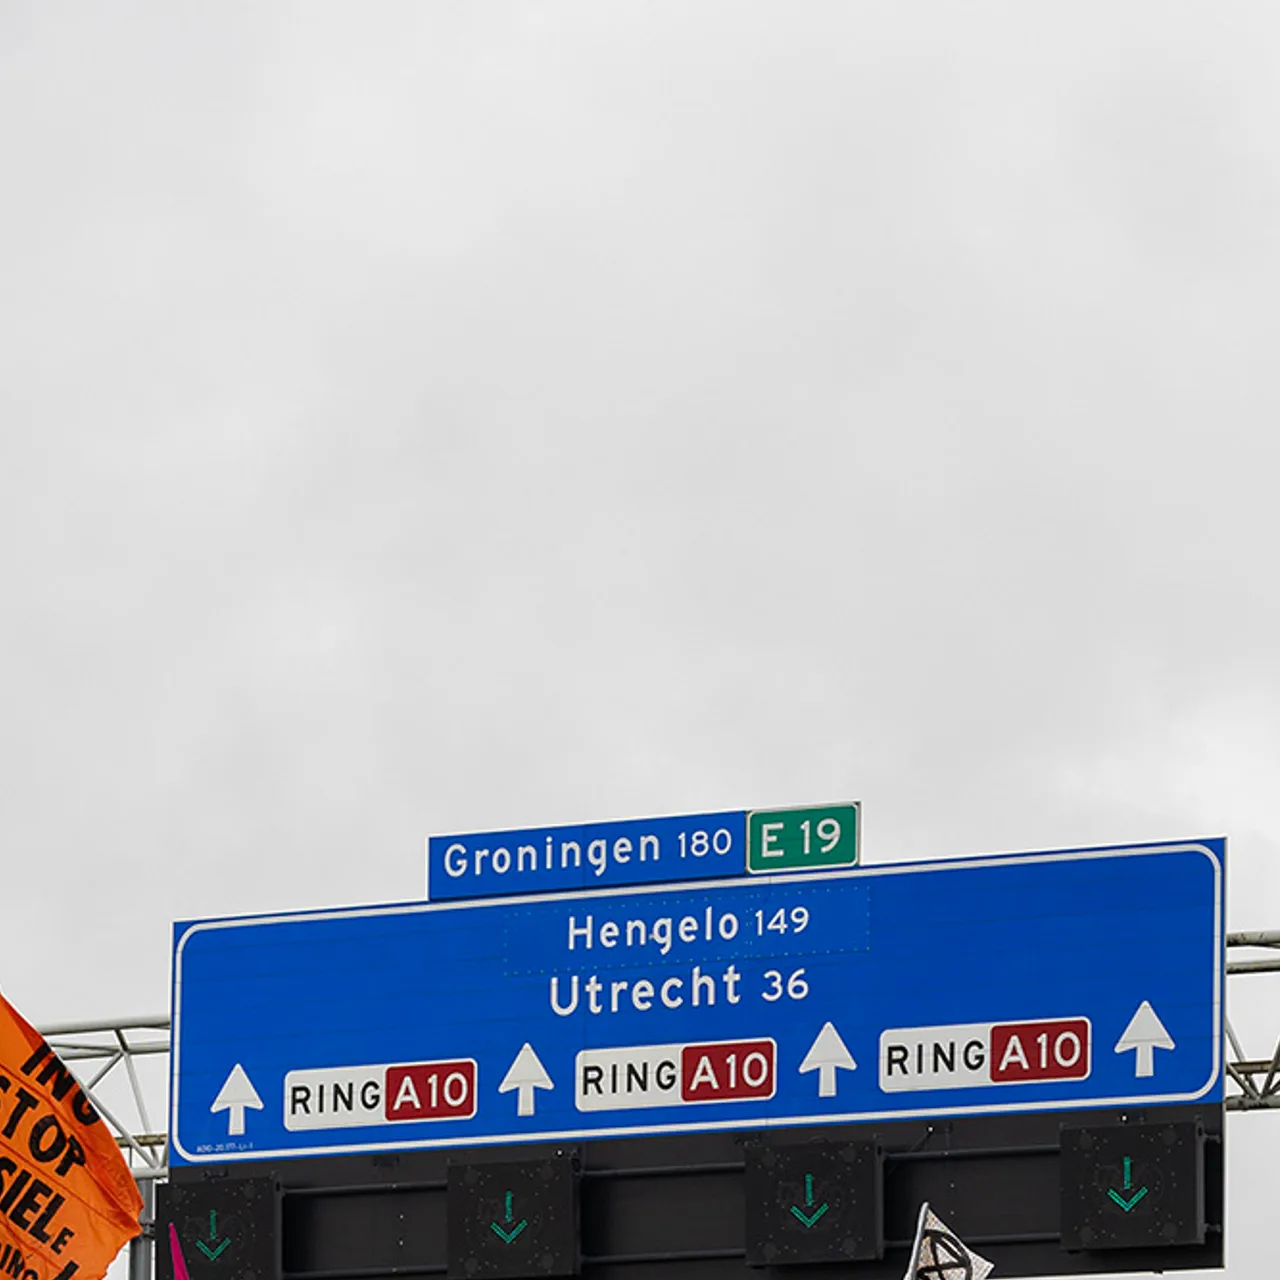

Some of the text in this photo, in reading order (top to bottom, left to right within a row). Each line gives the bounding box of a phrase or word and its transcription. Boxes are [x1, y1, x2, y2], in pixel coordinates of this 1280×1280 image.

[444, 829, 732, 877] Groningen 180
[761, 818, 841, 858] E 19
[568, 906, 809, 955] Hengelo 149
[550, 965, 809, 1016] Utrecht 36
[582, 1052, 768, 1096] RING A10
[887, 1031, 1081, 1077] RING A10
[21, 1042, 101, 1126] ING
[291, 1072, 468, 1115] RING A10
